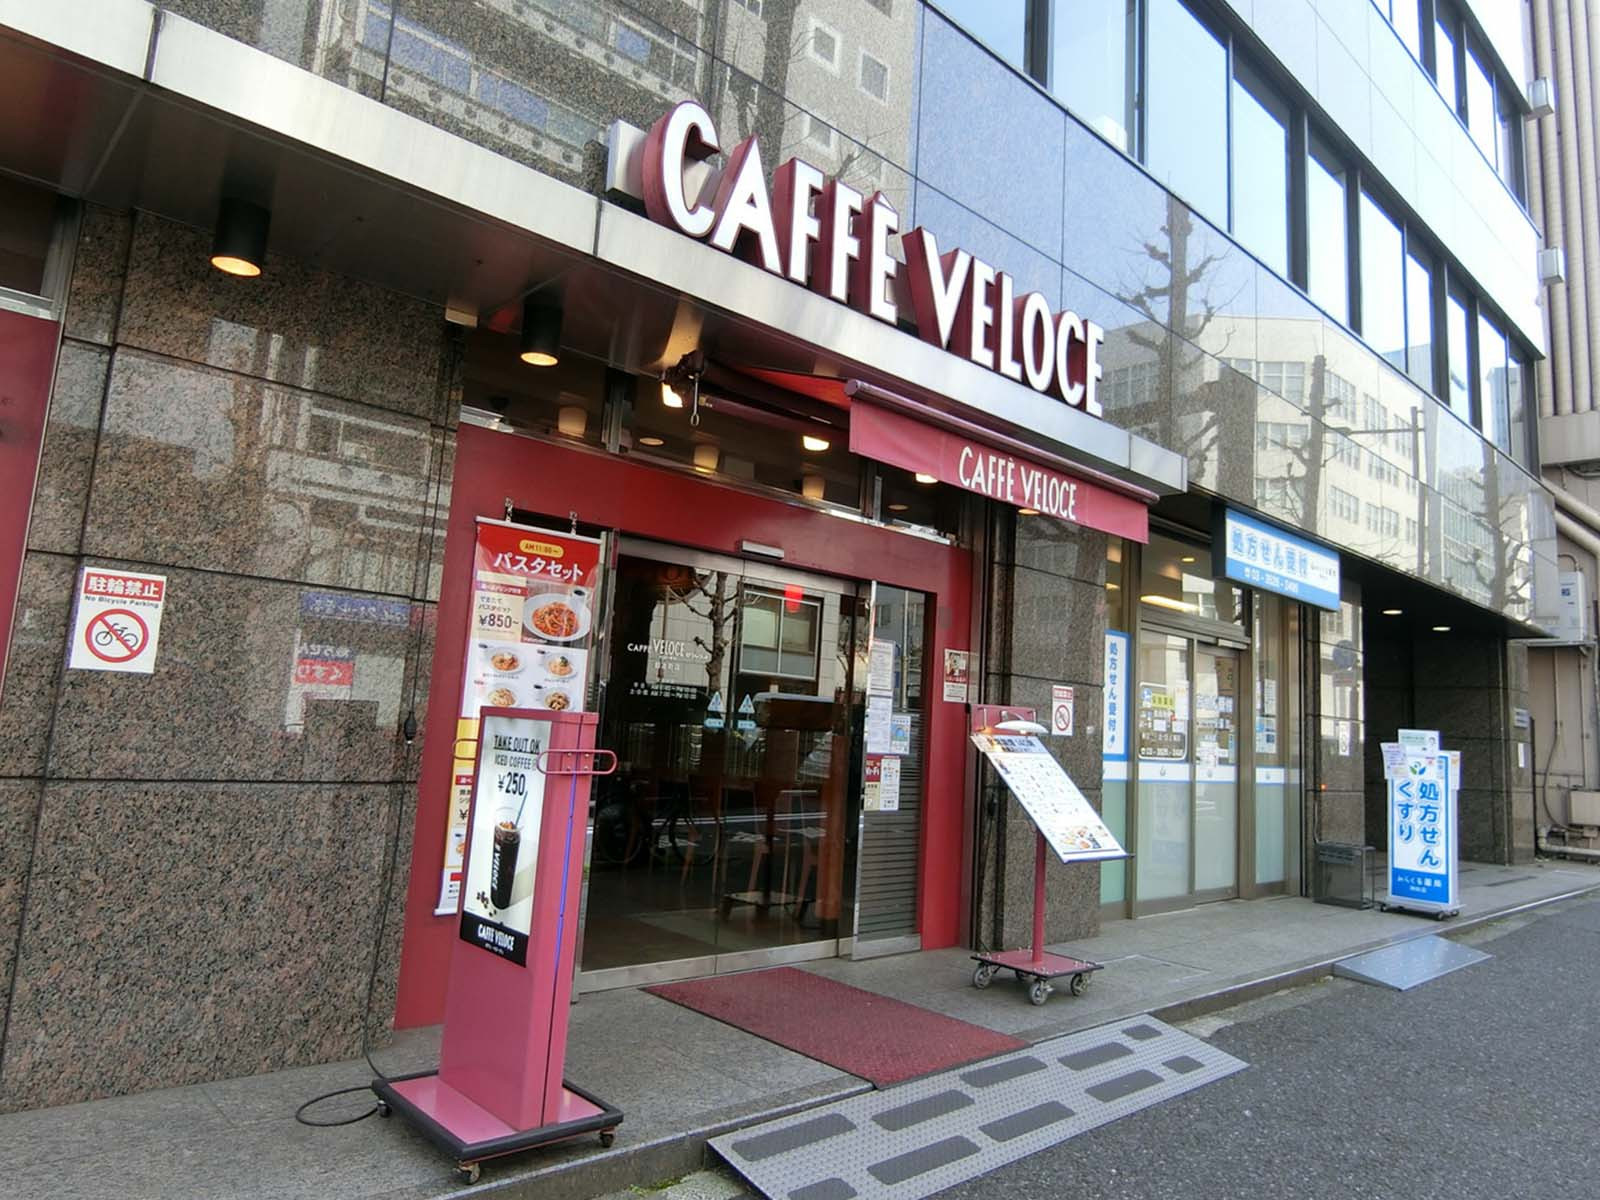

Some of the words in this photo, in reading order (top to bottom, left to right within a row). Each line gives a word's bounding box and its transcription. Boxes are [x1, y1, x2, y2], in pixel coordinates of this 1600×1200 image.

[905, 226, 1104, 420] VELOCE
[959, 446, 1015, 502] CAFFÈ
[1020, 465, 1077, 520] VELOCE
[493, 552, 583, 582] パスタセット
[88, 576, 160, 598] 駐輪禁止
[652, 638, 684, 658] VELOCE
[494, 735, 512, 750] TAKE
[513, 737, 529, 752] OUT
[494, 754, 508, 766] ICED
[509, 756, 532, 770] COFFEE
[1397, 782, 1413, 841] くすり
[1419, 782, 1439, 867] 処方せん
